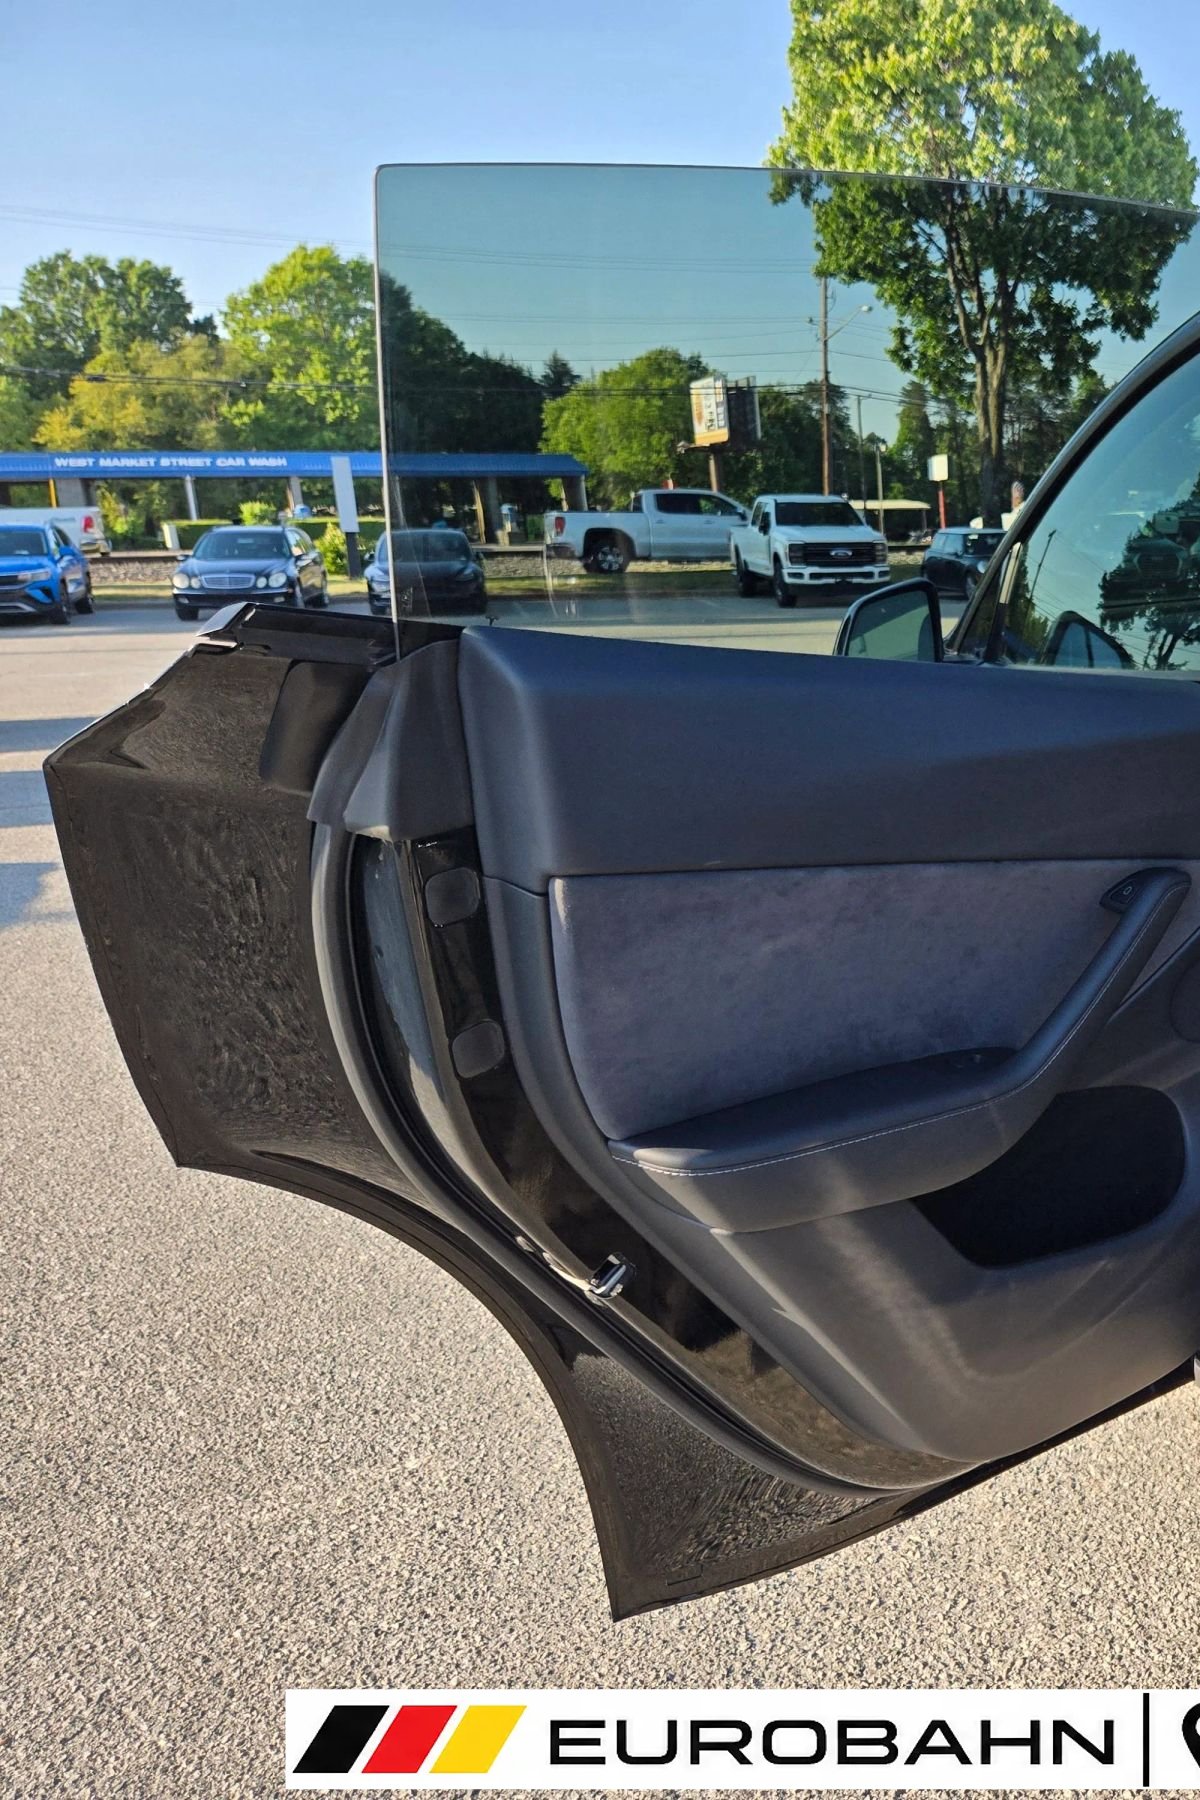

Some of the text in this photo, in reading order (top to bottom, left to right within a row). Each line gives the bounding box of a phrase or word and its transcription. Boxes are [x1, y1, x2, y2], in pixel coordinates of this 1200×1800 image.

[54, 457, 287, 467] WEST MARKET STREET CAR WASH
